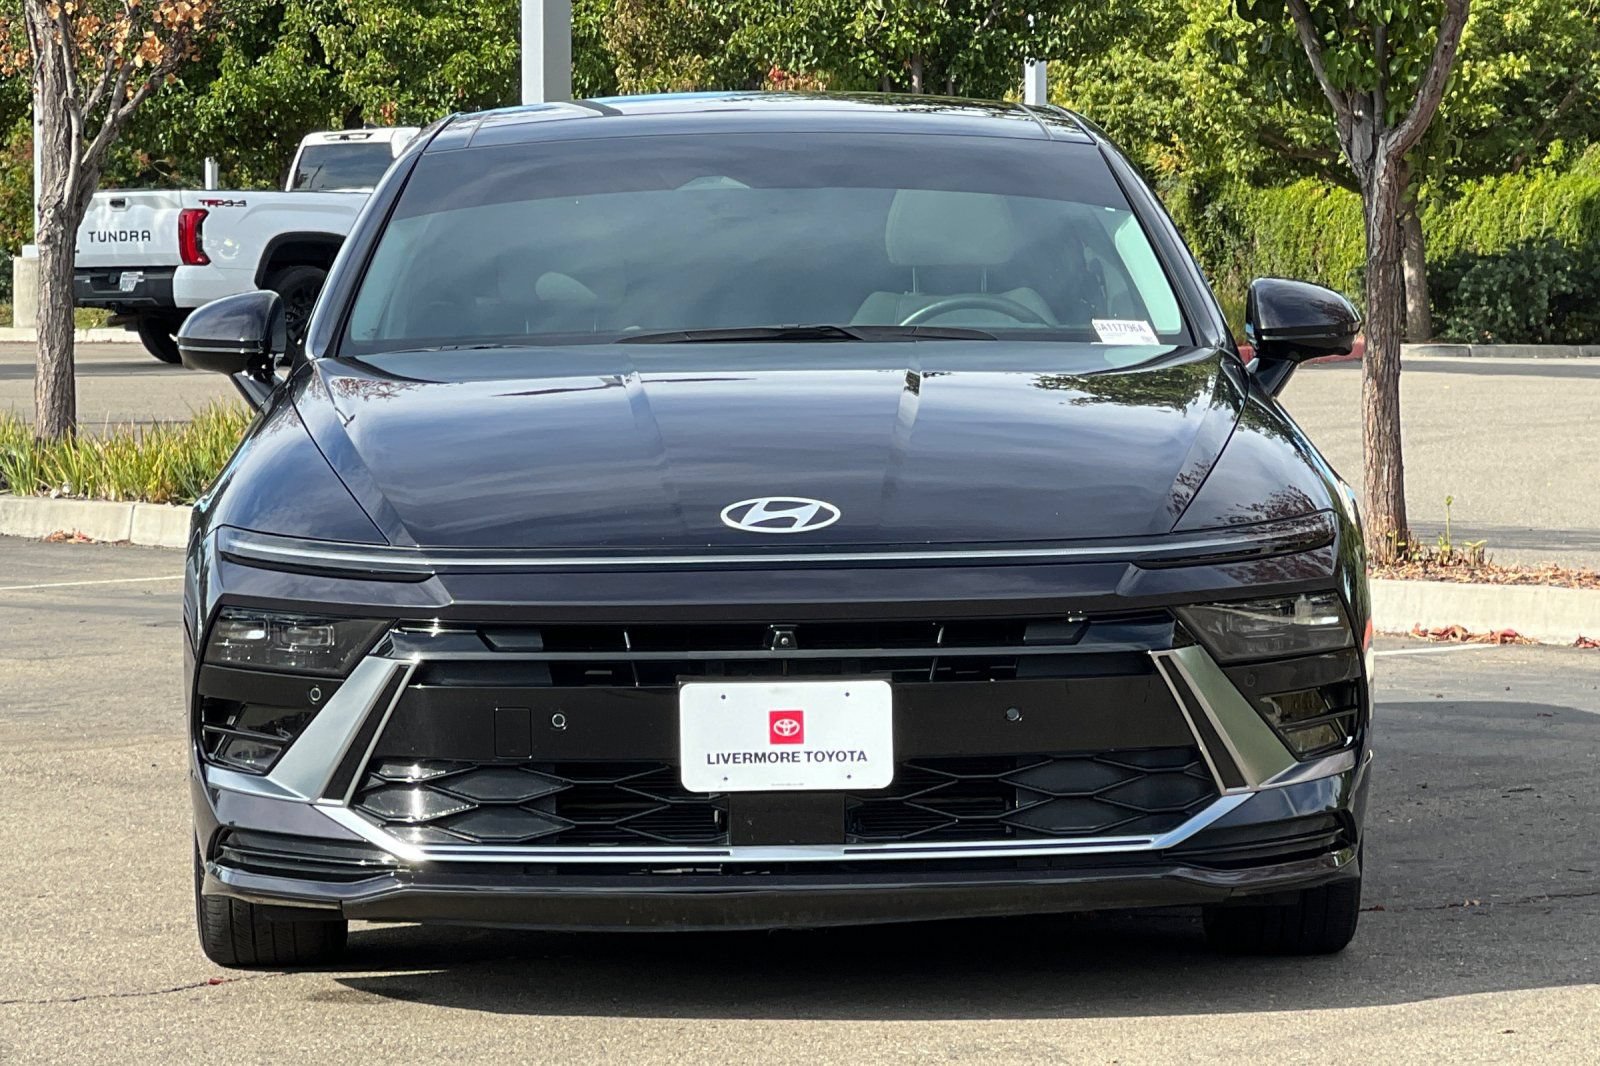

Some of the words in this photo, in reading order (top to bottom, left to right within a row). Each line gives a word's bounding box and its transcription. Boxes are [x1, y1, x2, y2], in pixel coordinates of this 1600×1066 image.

[88, 230, 151, 243] TUNDRA
[706, 751, 801, 765] LIVERMORE
[804, 750, 868, 763] TOYOTA
